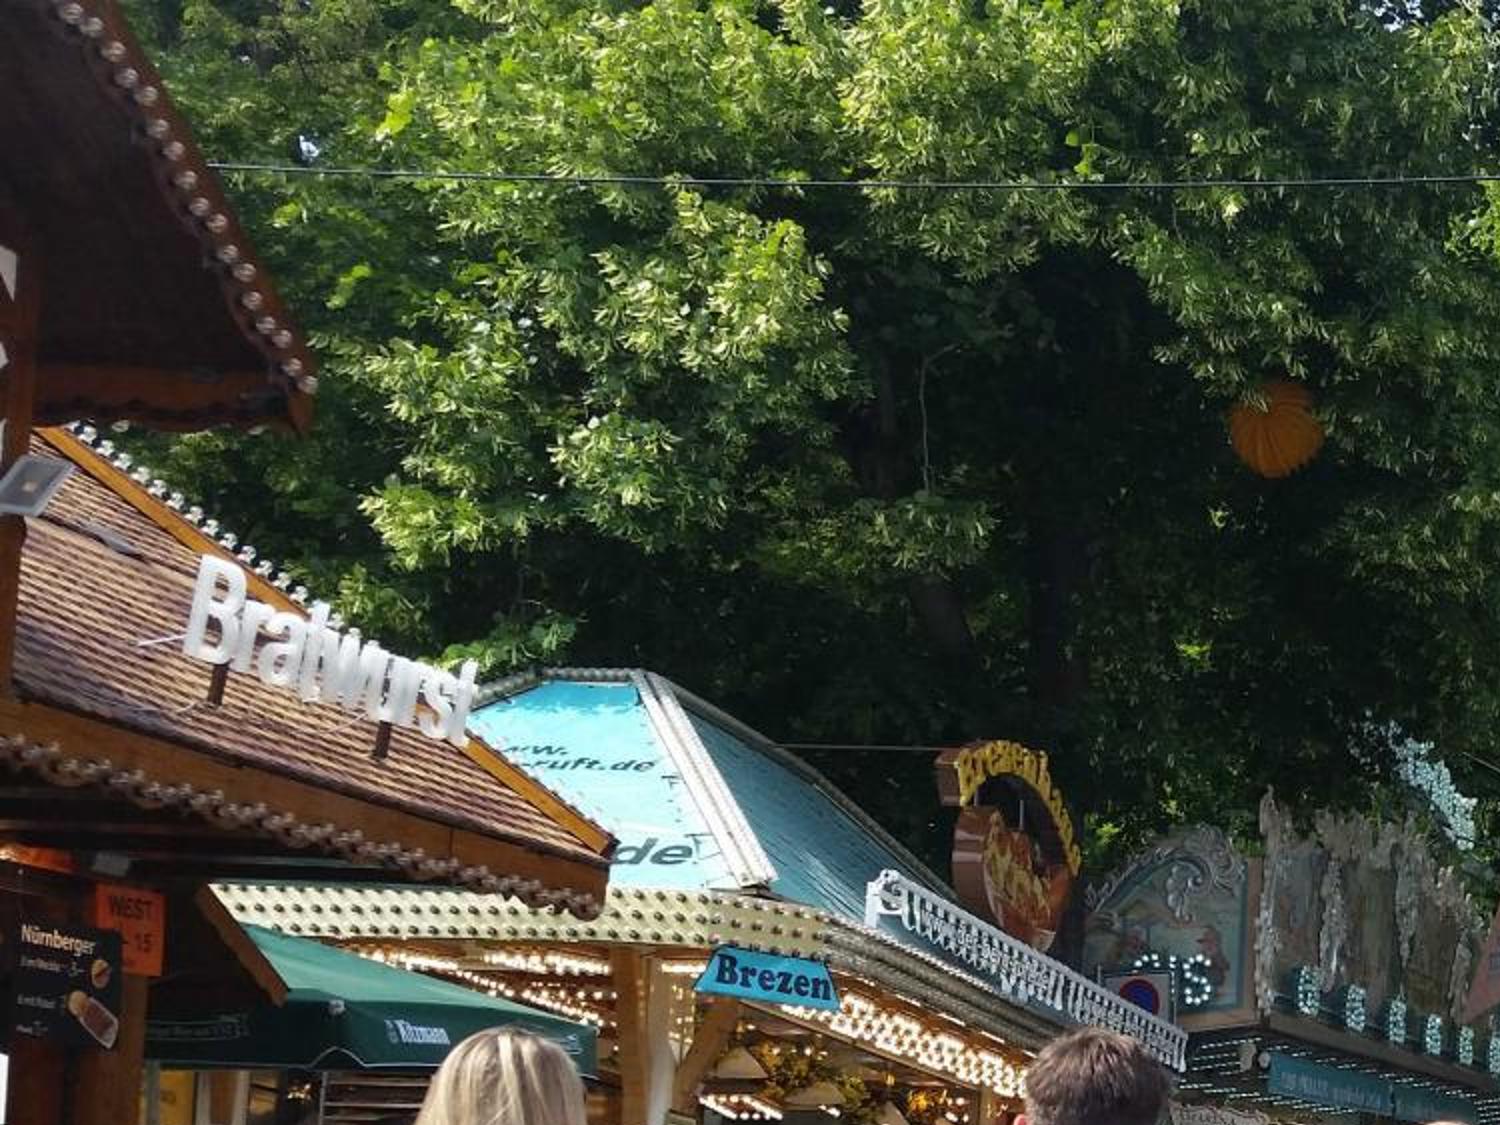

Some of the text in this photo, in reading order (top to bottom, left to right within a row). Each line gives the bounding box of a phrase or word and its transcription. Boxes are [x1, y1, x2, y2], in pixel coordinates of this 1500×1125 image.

[184, 554, 480, 746] Bratwurst
[21, 923, 96, 957] Nürnberger
[715, 953, 832, 1001] Brezen
